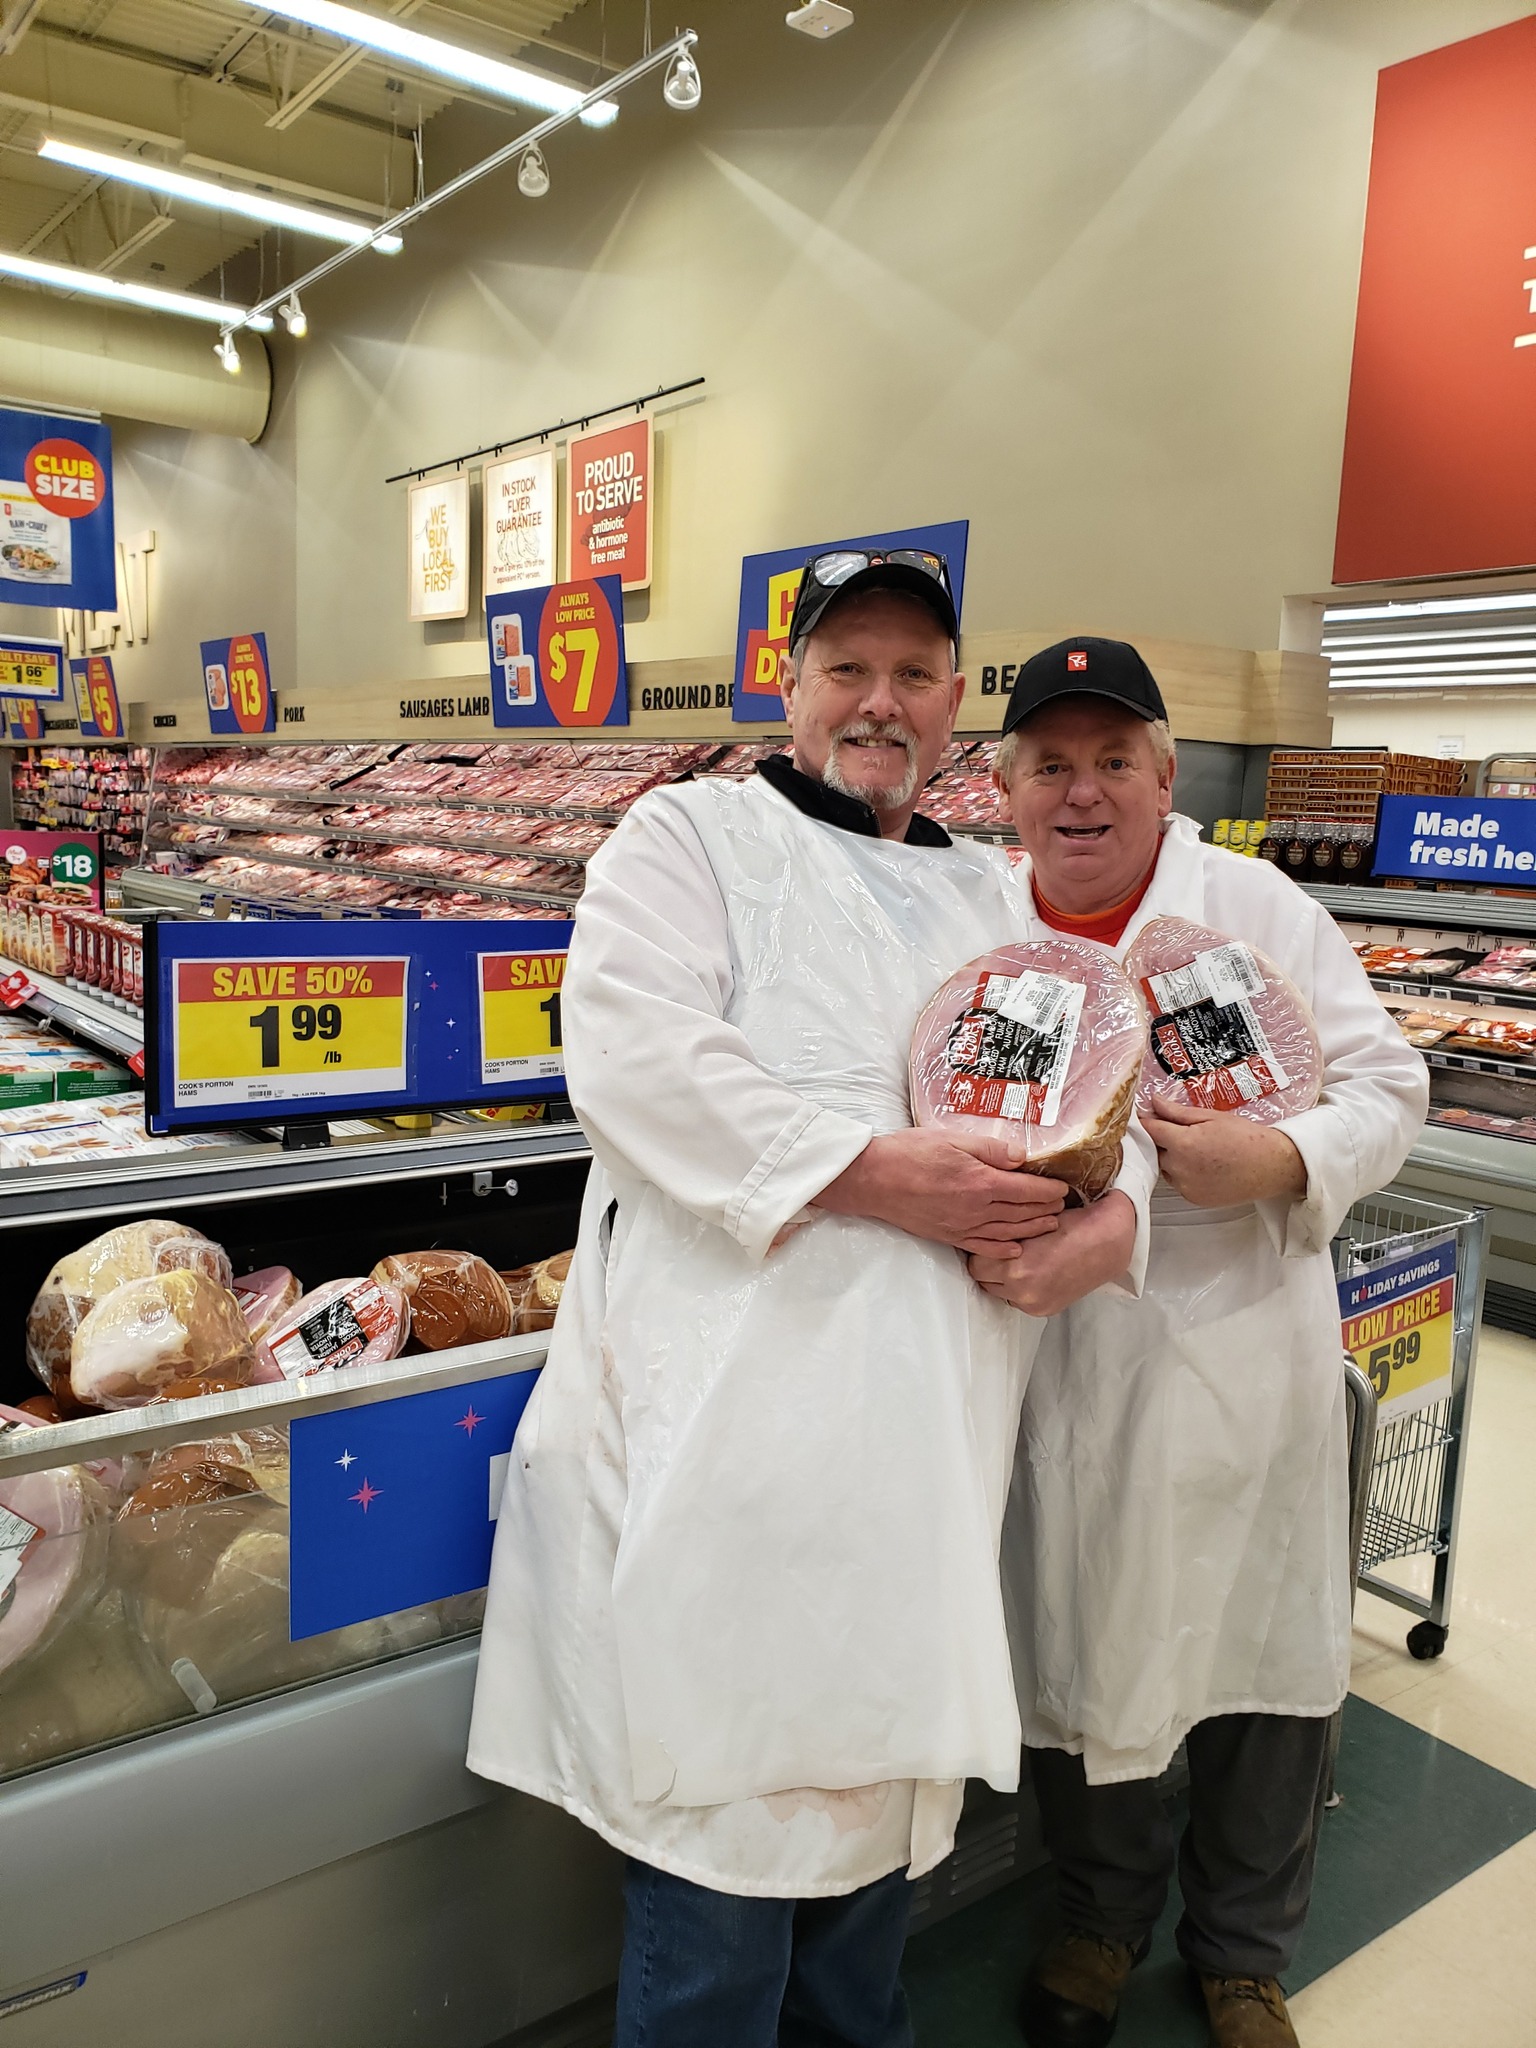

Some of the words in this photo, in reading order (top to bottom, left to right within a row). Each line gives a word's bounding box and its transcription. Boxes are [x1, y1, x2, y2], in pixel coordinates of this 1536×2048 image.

[34, 455, 95, 479] CLUB
[585, 451, 634, 487] PROUD
[35, 474, 96, 501] SIZE
[502, 482, 509, 497] IN
[511, 475, 536, 495] STOCK
[576, 489, 594, 516] TO
[596, 475, 643, 511] SERVE
[430, 504, 447, 526] WE
[507, 496, 531, 514] FLYER
[496, 511, 542, 534] GUARANTEE
[592, 516, 624, 535] antibiotic
[428, 526, 449, 549] BUY
[588, 536, 595, 550] &
[596, 532, 628, 548] hormone
[422, 548, 455, 572] LOCAL
[591, 550, 605, 564] free
[607, 546, 625, 561] meat
[424, 570, 452, 593] FIRST
[559, 592, 589, 608] ALWAYS
[555, 610, 573, 623] LOW
[574, 607, 595, 621] PRICE
[549, 627, 600, 713] $7
[230, 668, 262, 716] $13
[642, 685, 711, 709] GROUND
[715, 683, 735, 708] BE
[93, 686, 113, 731] $5
[284, 706, 305, 722] PORK
[400, 698, 455, 718] SAUSAGES
[458, 696, 490, 716] LAMB
[1413, 811, 1500, 839] Made
[52, 854, 93, 878] $18
[1409, 840, 1488, 867] fresh
[1493, 844, 1536, 871] he
[213, 966, 296, 998] SAVE
[305, 965, 373, 995] 50%
[250, 1005, 280, 1068] 1
[291, 1003, 342, 1041] 99
[996, 1056, 1008, 1073] HAM
[1004, 1019, 1016, 1038] NOYE
[323, 1051, 342, 1065] /lb
[1163, 1029, 1187, 1067] Cook's
[484, 1067, 501, 1075] HAMS
[505, 1059, 529, 1067] PORTION
[986, 1048, 1000, 1077] SMOKED
[178, 1082, 204, 1090] COOK'S
[178, 1089, 198, 1097] HAMS
[1397, 1259, 1440, 1286] SAVINGS
[1348, 1313, 1388, 1349] LOW
[1392, 1287, 1440, 1332] PRICE
[1370, 1344, 1391, 1400] 5
[1392, 1331, 1421, 1370] 99
